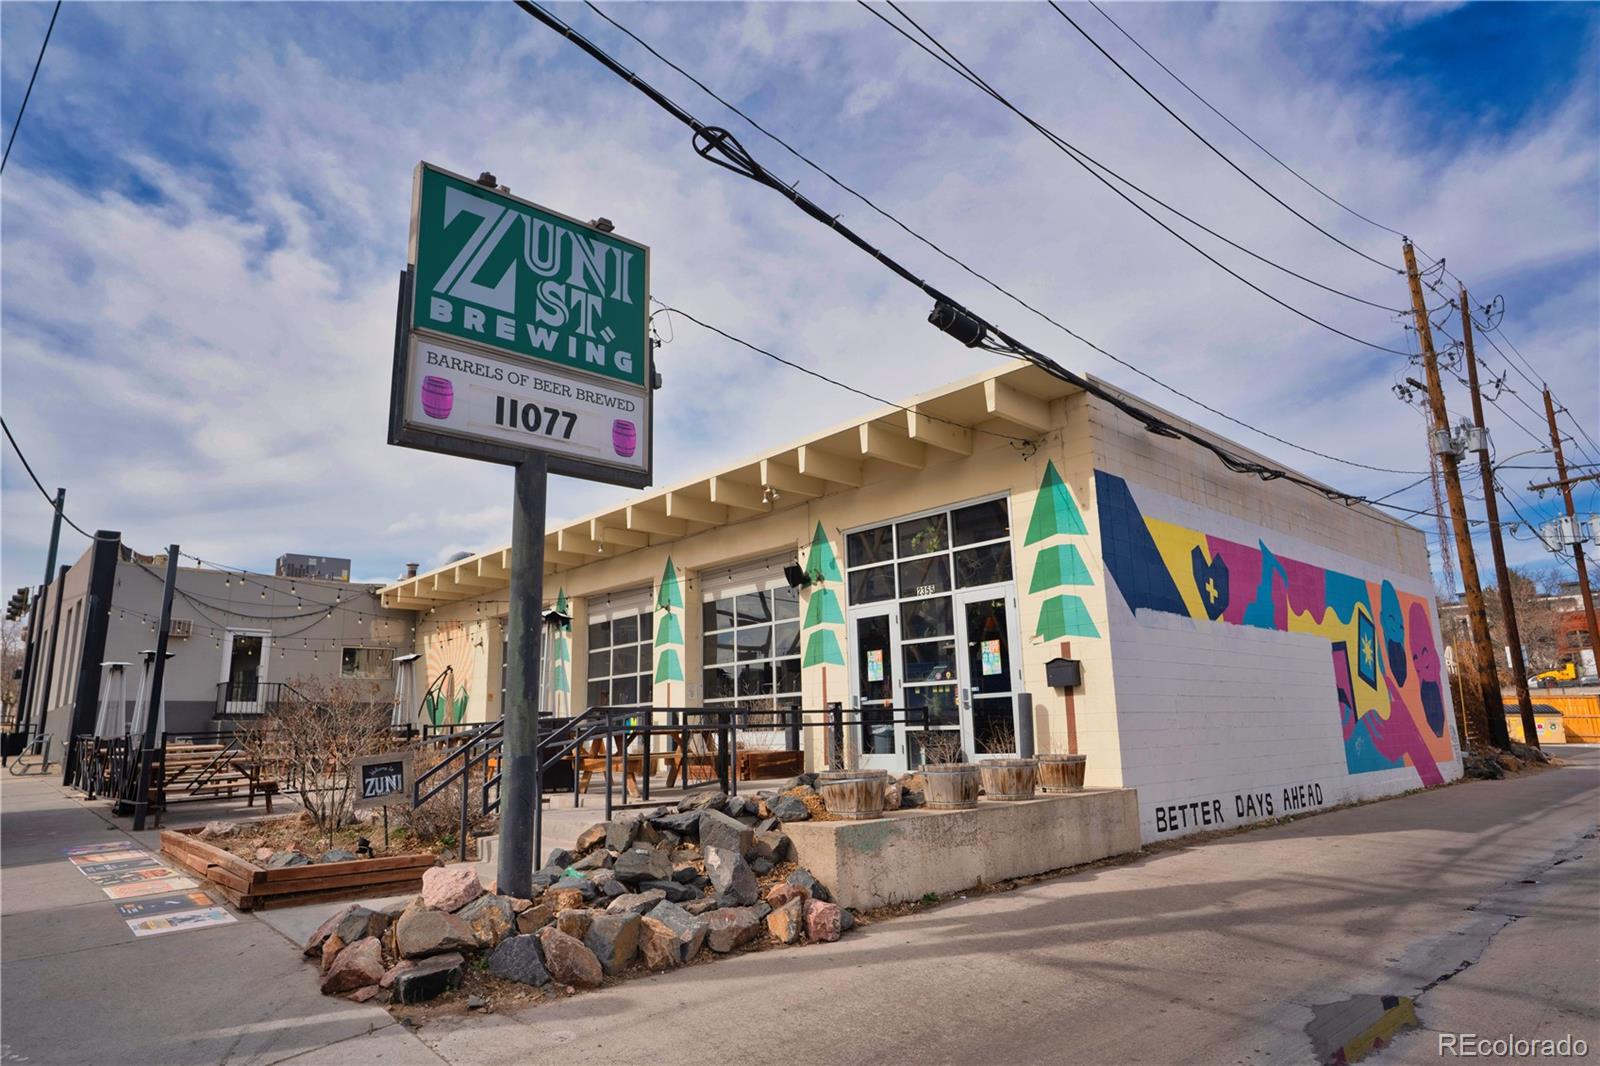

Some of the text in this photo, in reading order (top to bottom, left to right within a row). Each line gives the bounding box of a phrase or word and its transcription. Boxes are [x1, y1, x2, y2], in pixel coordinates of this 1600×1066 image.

[432, 185, 634, 314] ZUNI
[430, 296, 633, 374] BREWING
[427, 351, 636, 412] BARRELS OF BEER BREWED
[496, 396, 578, 440] 11077
[917, 585, 936, 596] 2355
[365, 774, 402, 797] ZUNI
[1155, 783, 1323, 833] BETTER DAYS AHEAD
